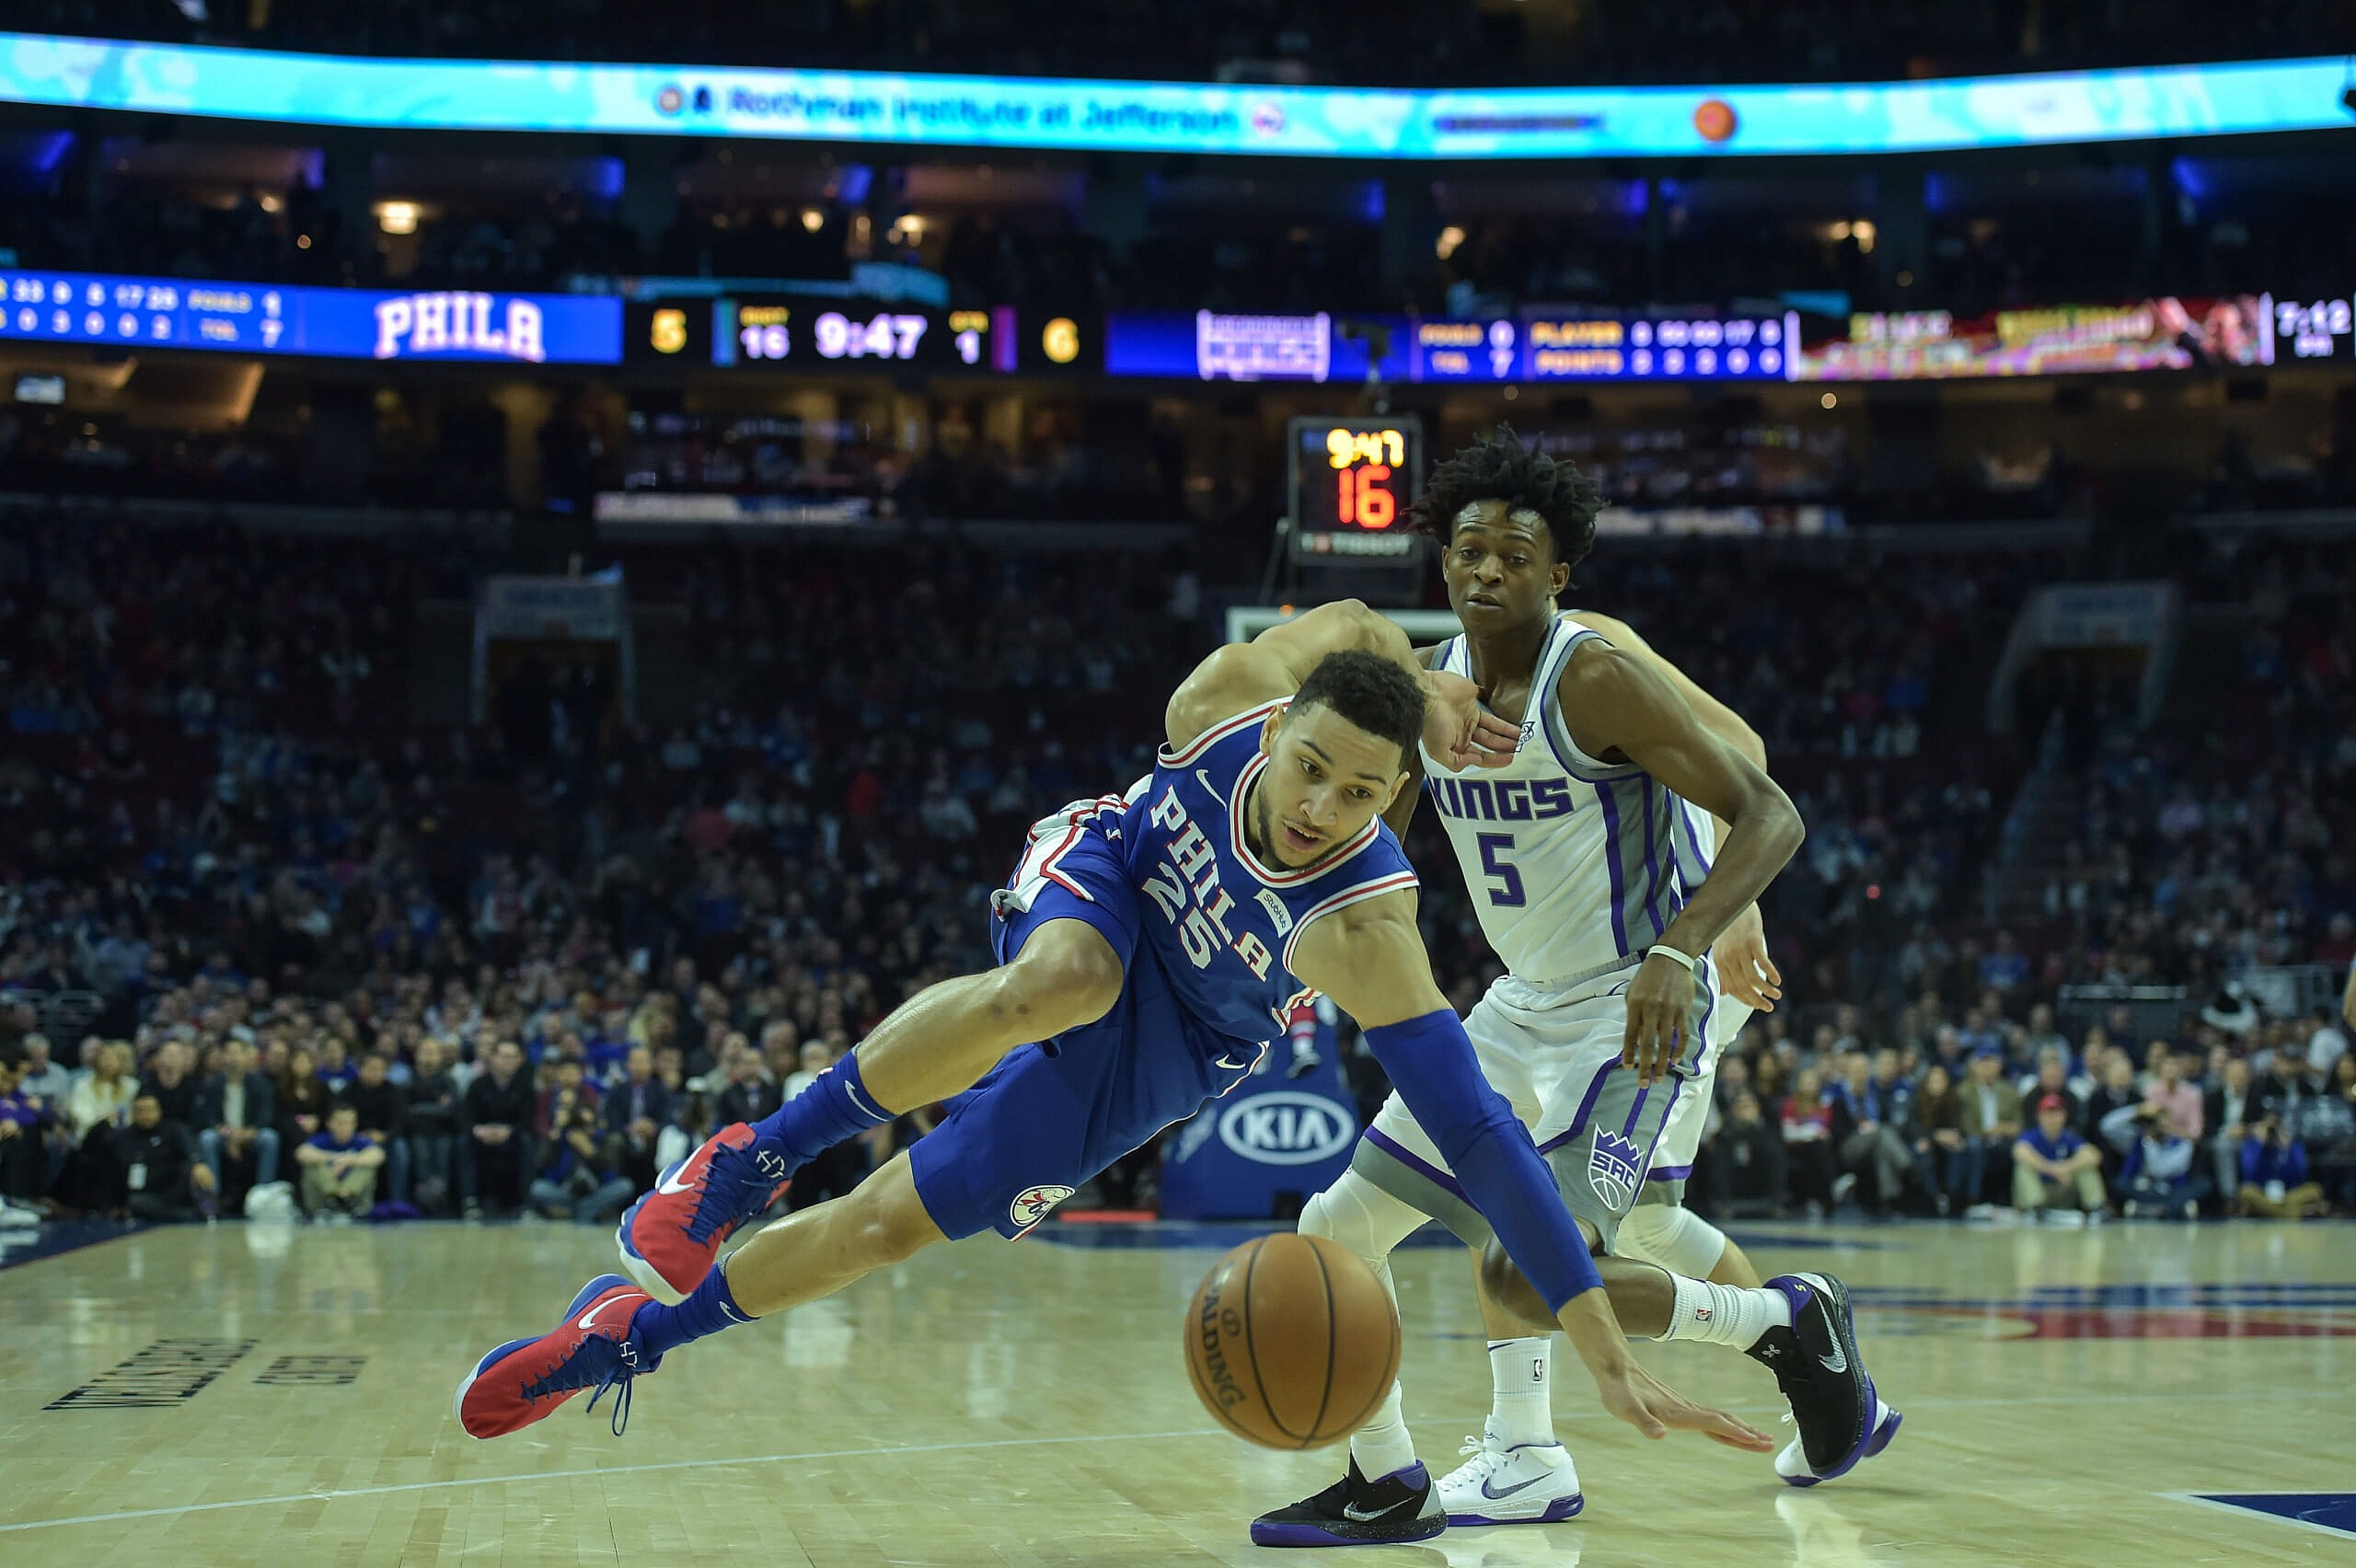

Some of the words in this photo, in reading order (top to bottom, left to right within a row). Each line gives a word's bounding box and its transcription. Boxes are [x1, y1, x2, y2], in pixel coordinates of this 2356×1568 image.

[374, 292, 546, 363] PHILA
[651, 308, 687, 353] 5
[740, 324, 791, 359] 16
[814, 312, 928, 359] 9:47
[955, 329, 980, 364] 1
[1043, 317, 1080, 363] 6
[1327, 428, 1404, 468] 9:47
[1339, 465, 1394, 528] 16
[1149, 784, 1274, 983] PHILA
[1476, 832, 1527, 908] 5
[1142, 861, 1221, 969] 25
[1263, 894, 1287, 928] StubHub
[1243, 1106, 1333, 1149] KIA
[1590, 1151, 1636, 1192] SAC
